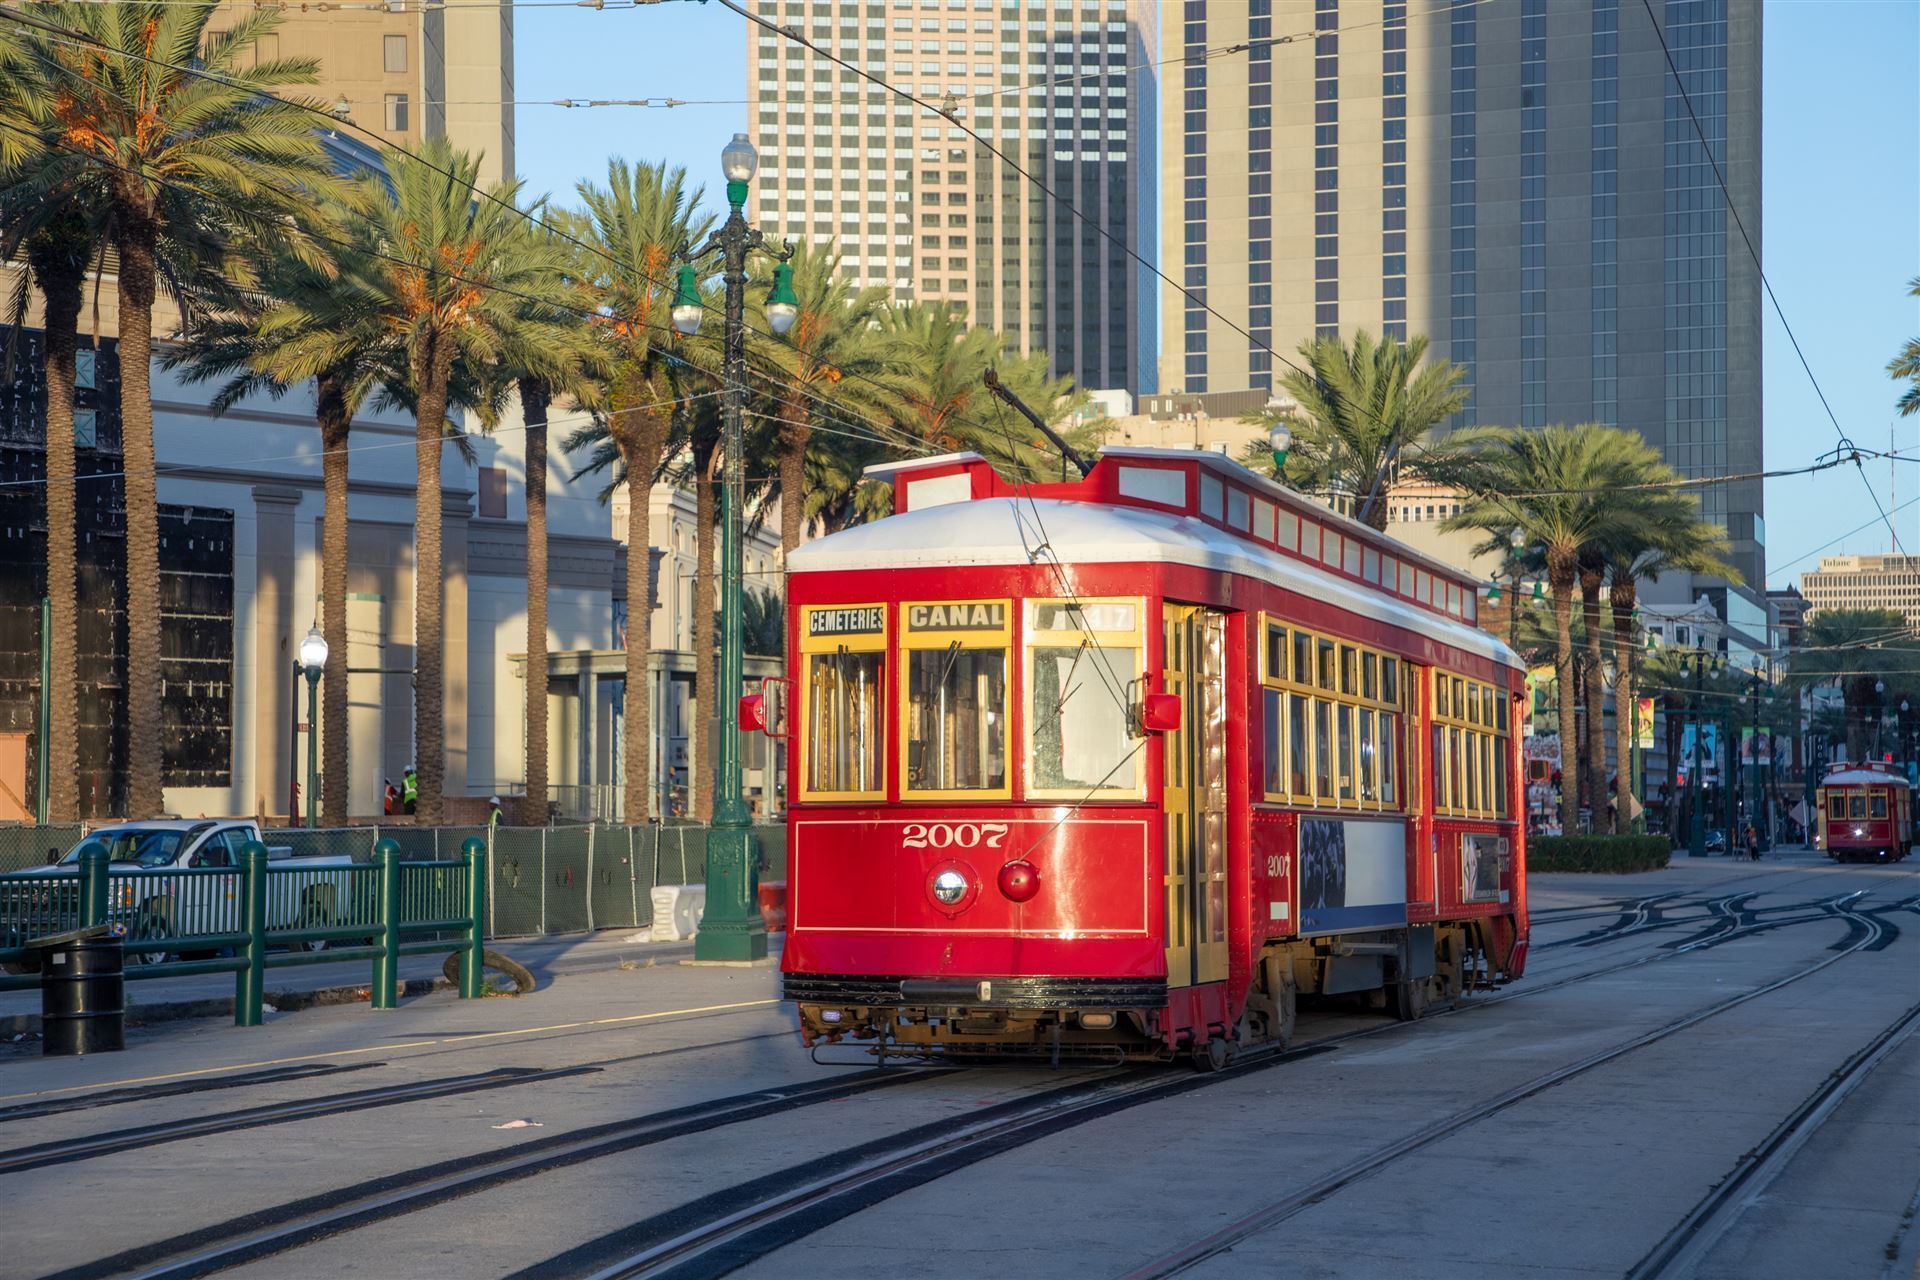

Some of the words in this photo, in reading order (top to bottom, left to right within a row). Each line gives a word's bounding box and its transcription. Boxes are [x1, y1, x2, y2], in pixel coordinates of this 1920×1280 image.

[810, 608, 883, 632] CEMETERIES
[910, 604, 1004, 627] CANAL
[902, 823, 1009, 848] 2007
[1267, 855, 1290, 878] 2007
